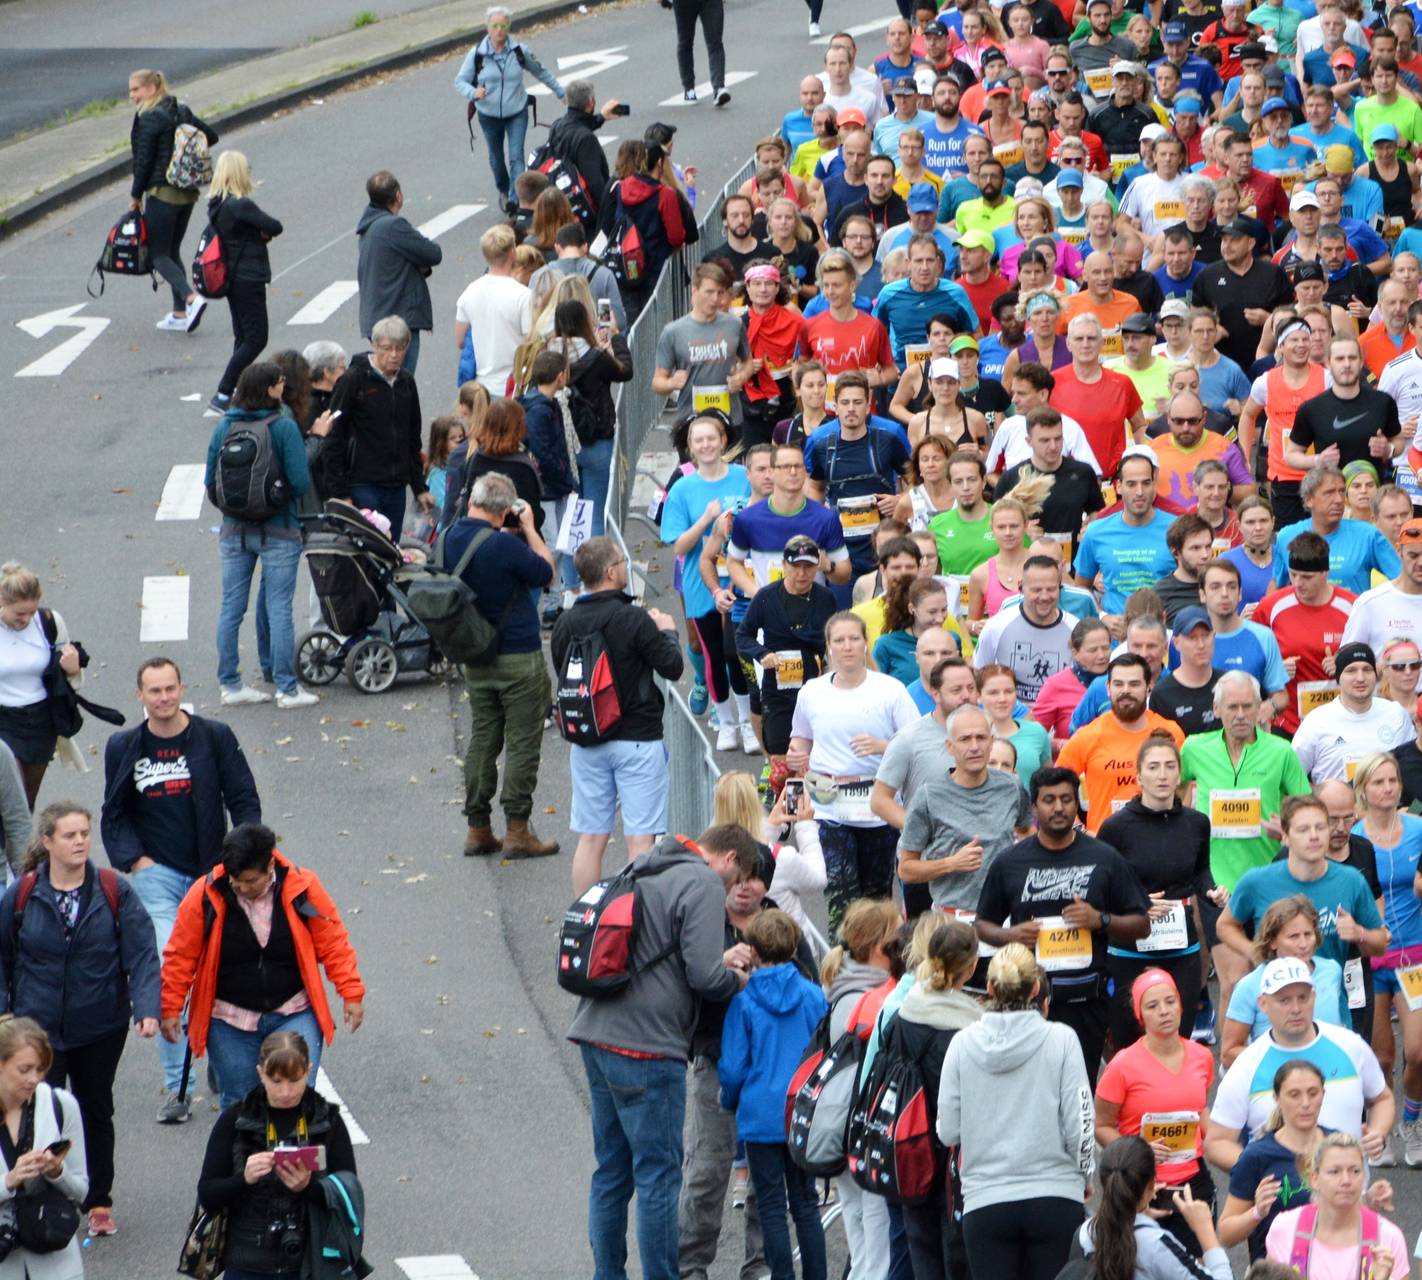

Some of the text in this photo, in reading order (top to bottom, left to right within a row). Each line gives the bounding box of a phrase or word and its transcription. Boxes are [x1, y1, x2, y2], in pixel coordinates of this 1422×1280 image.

[928, 137, 961, 153] Run for
[704, 396, 720, 405] 505
[1104, 759, 1134, 770] Aus
[1222, 802, 1250, 812] 4090
[1050, 928, 1080, 942] 4279
[1080, 1089, 1094, 1133] MISS
[1152, 1125, 1188, 1139] F4661
